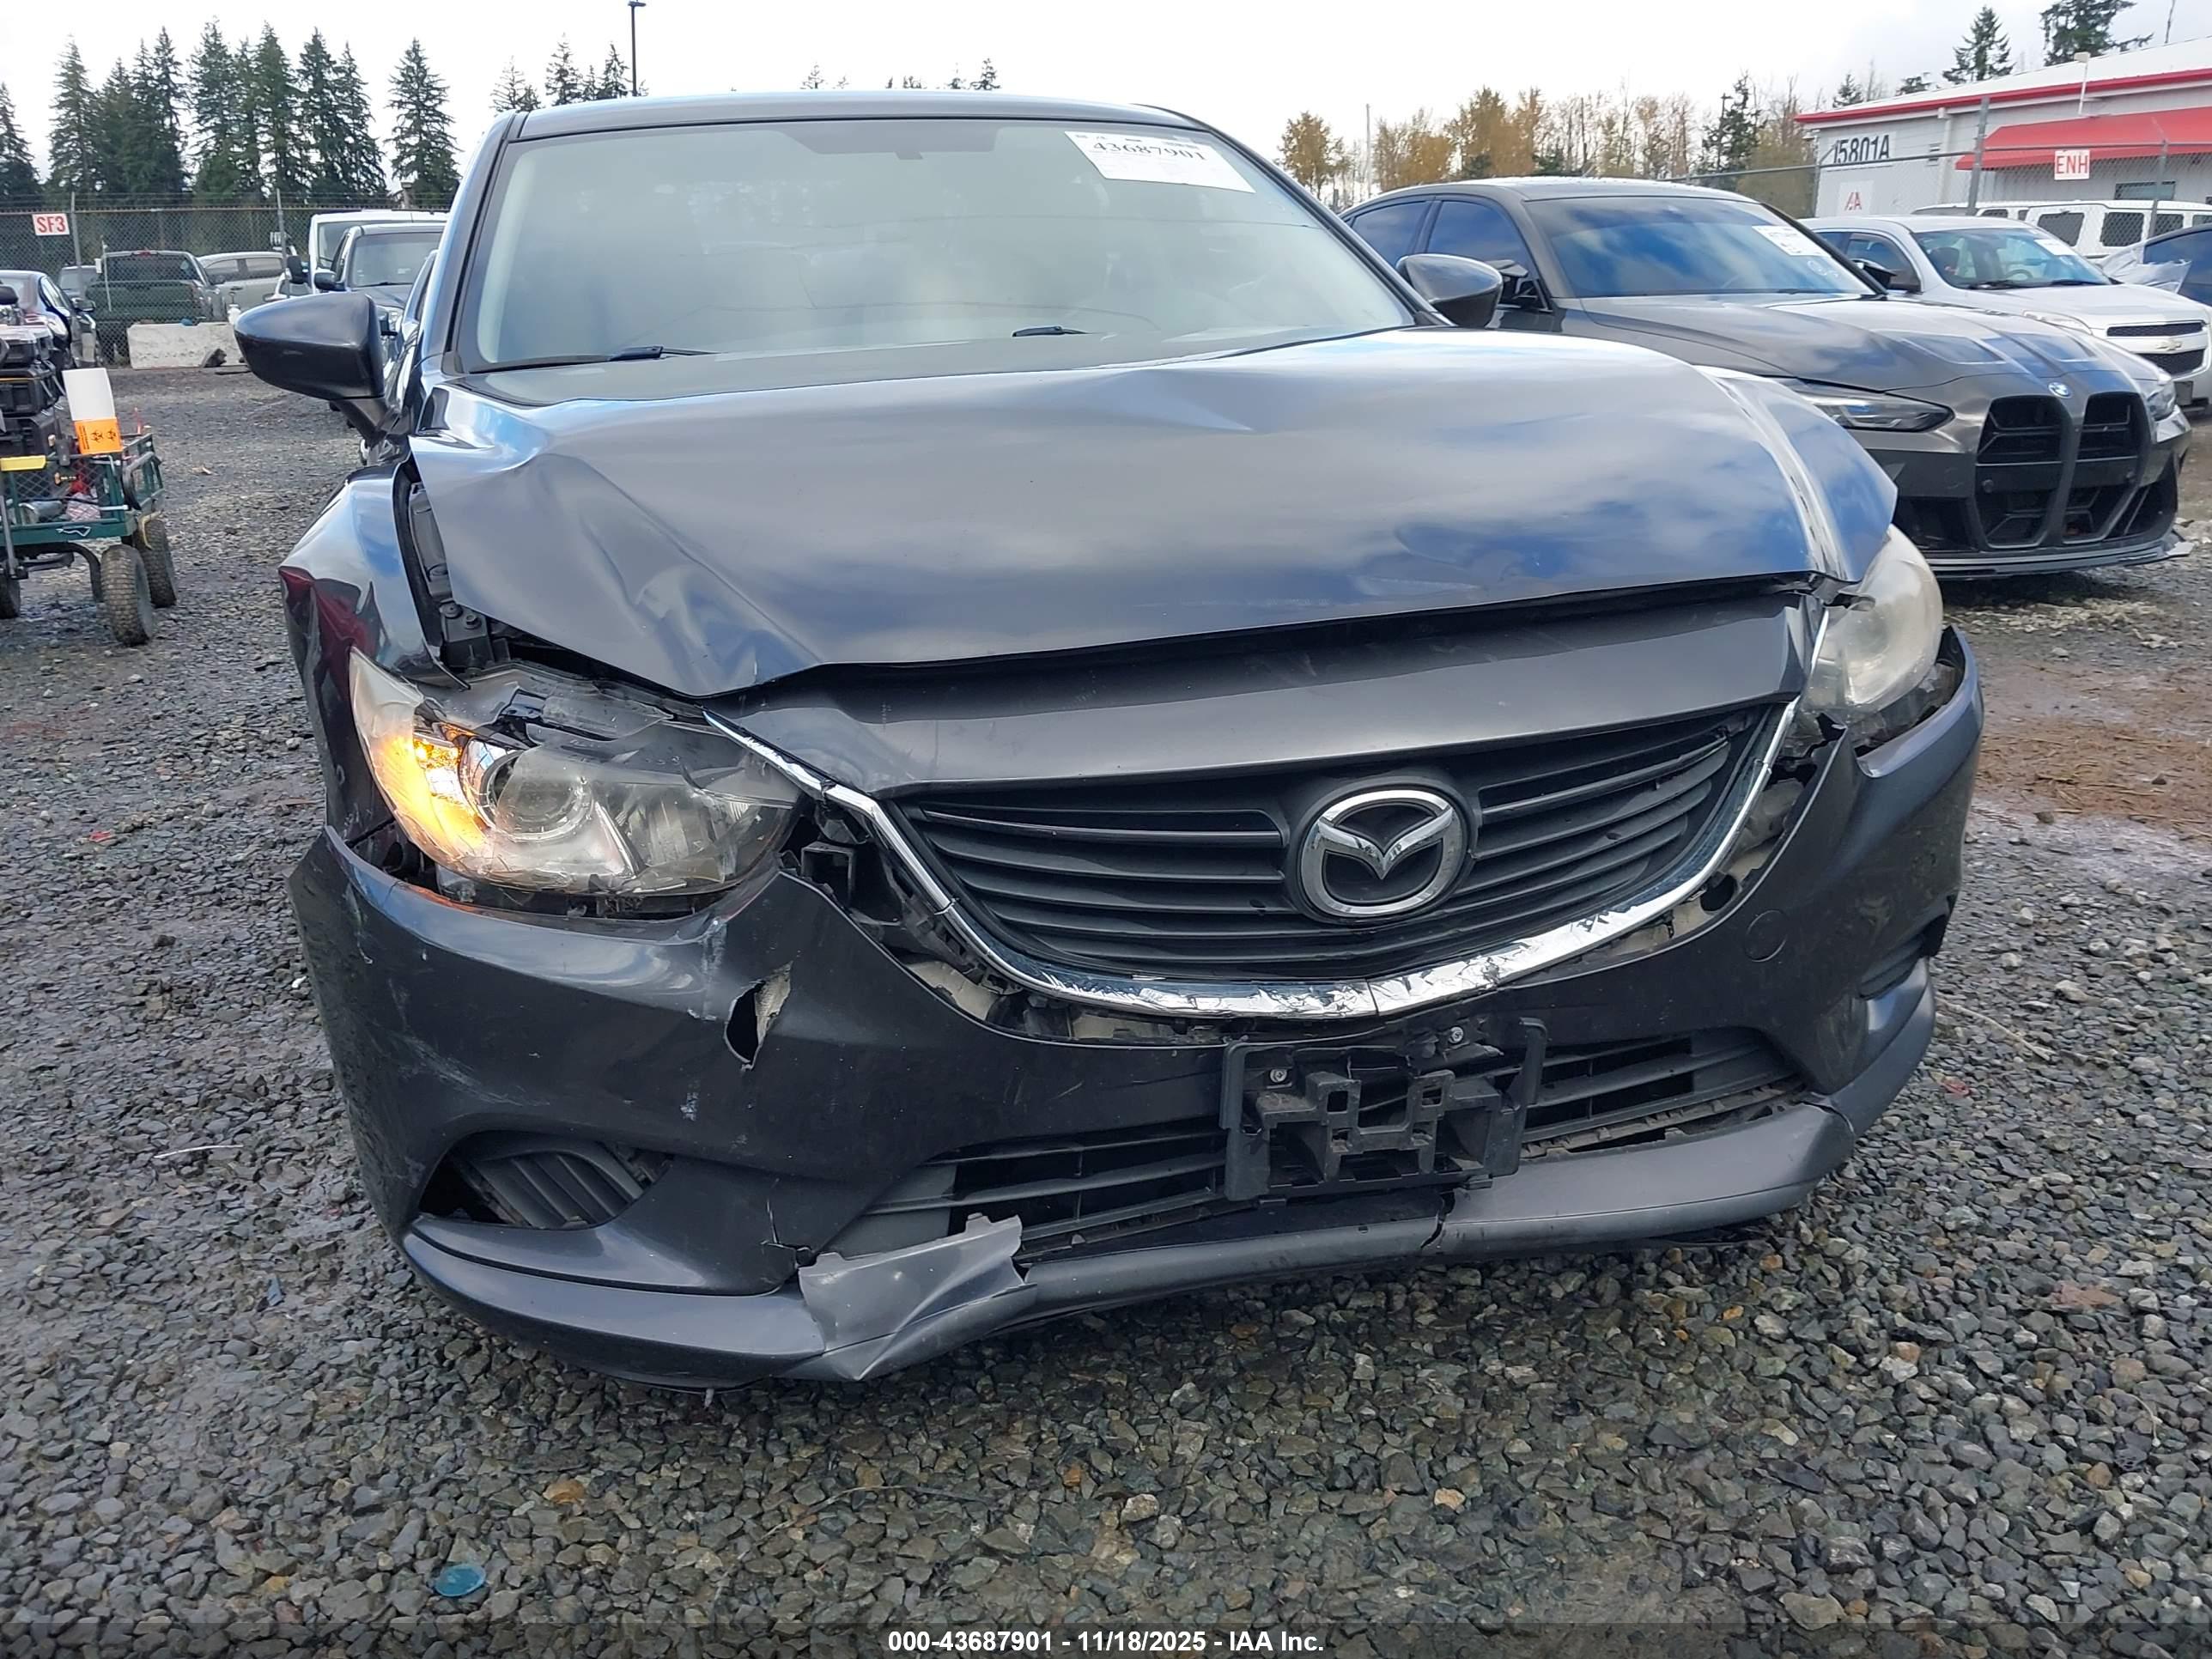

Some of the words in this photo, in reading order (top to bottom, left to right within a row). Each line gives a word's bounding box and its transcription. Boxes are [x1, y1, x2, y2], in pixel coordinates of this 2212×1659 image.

[1093, 142, 1206, 160] 43687901
[2057, 155, 2088, 173] ENH
[36, 216, 65, 233] SF3
